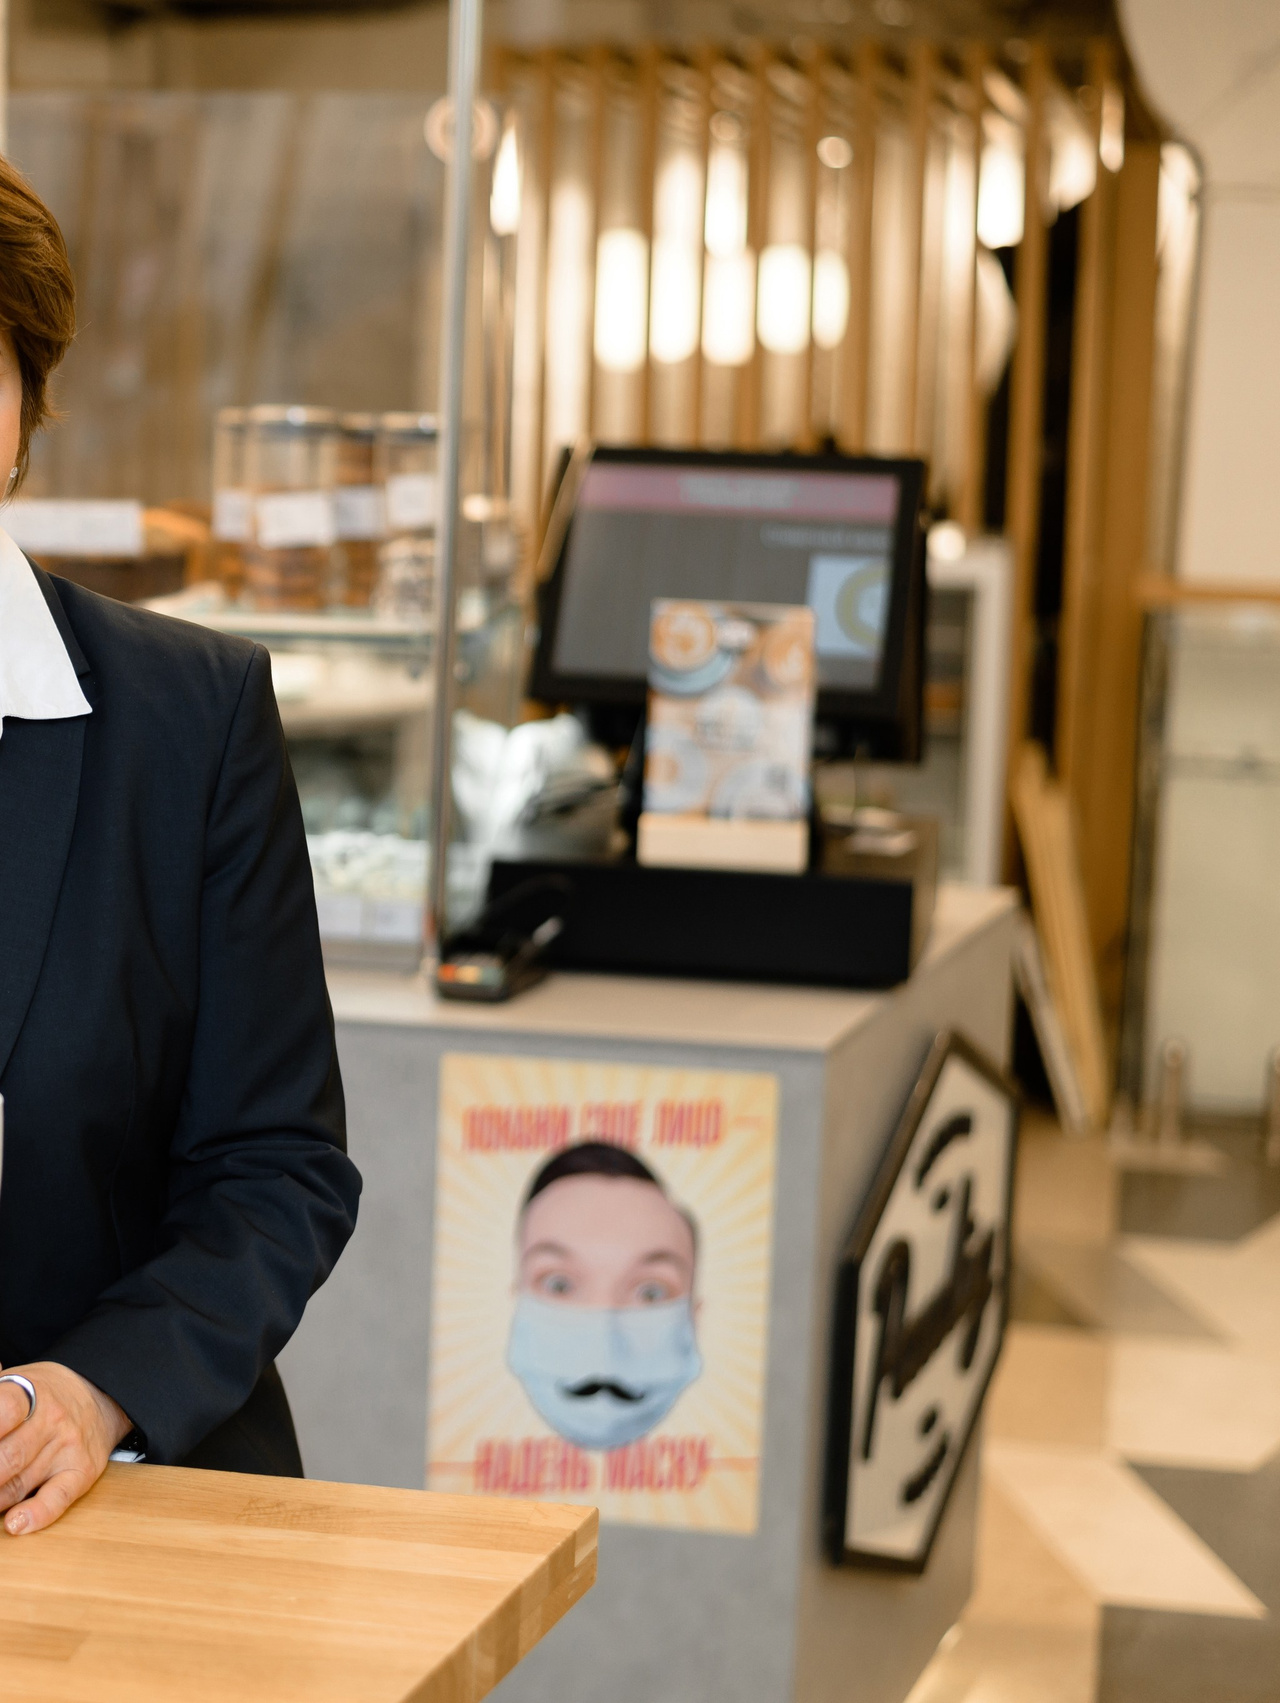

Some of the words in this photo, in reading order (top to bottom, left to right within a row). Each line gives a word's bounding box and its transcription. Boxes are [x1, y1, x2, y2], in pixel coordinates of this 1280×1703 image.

[653, 1101, 723, 1148] ЛИЦО
[475, 1437, 591, 1492] НАДЕНЬ
[602, 1435, 710, 1490] МАСКУ
